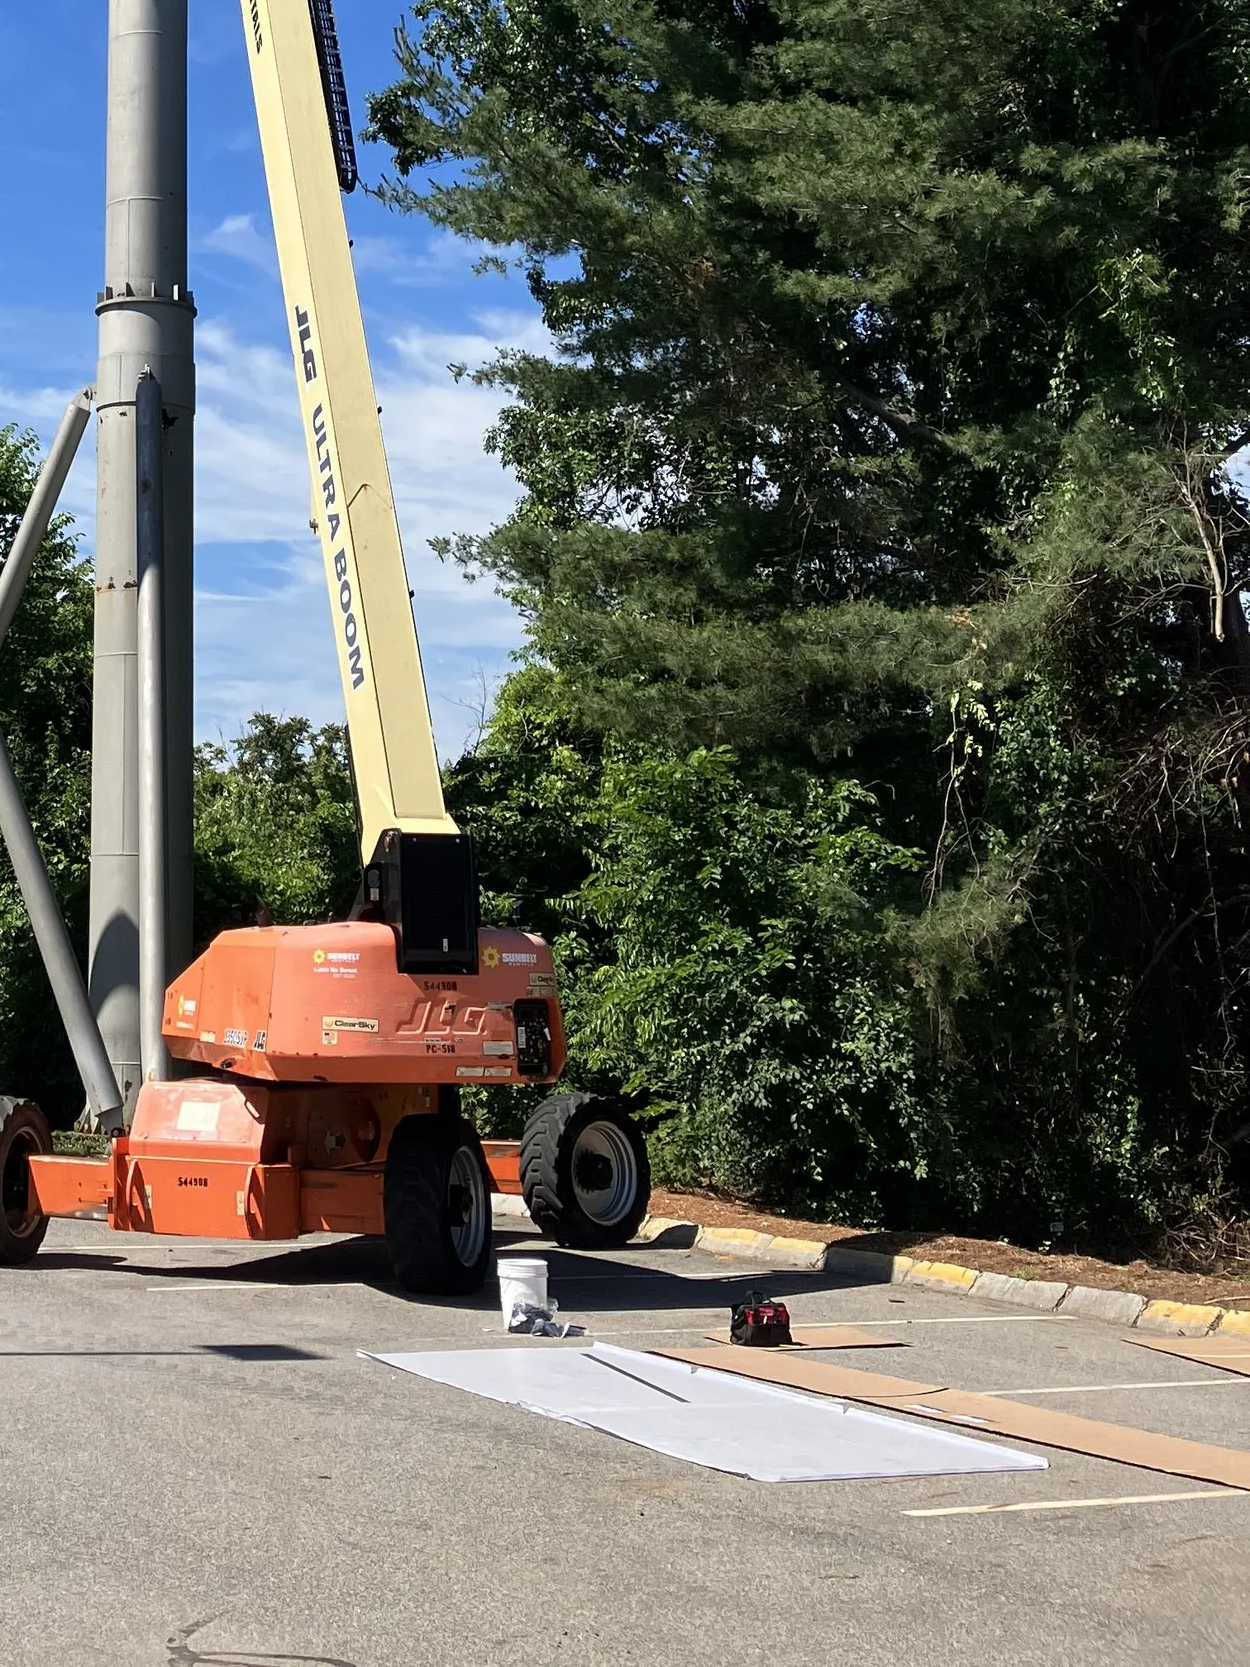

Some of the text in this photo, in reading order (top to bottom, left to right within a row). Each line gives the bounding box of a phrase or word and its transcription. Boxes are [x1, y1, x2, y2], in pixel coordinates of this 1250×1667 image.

[295, 304, 366, 692] JLG ULTRA BOOM
[502, 953, 538, 964] SUNBELT
[396, 997, 489, 1036] JLG
[334, 1019, 377, 1031] ClearSky
[178, 1176, 208, 1187] 544908
